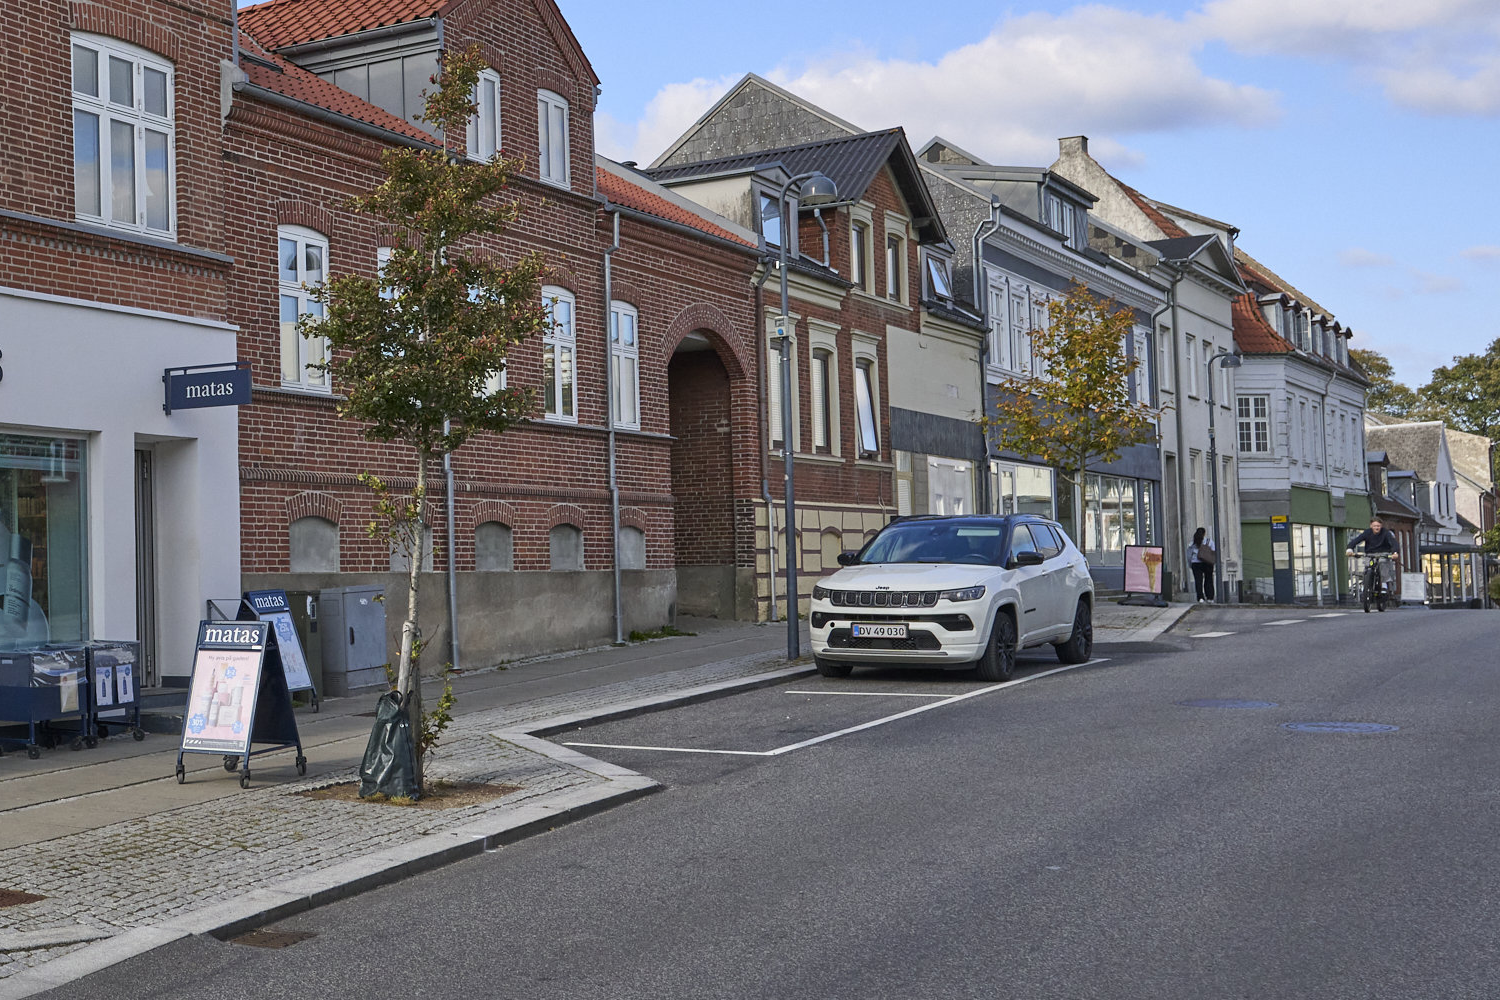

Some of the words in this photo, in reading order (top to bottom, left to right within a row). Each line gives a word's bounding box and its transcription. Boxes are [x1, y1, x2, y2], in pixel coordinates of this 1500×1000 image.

[186, 381, 234, 398] matas
[254, 594, 285, 609] matas
[204, 627, 260, 643] matas
[859, 627, 872, 635] DV
[874, 627, 885, 636] 49
[887, 627, 905, 636] 030
